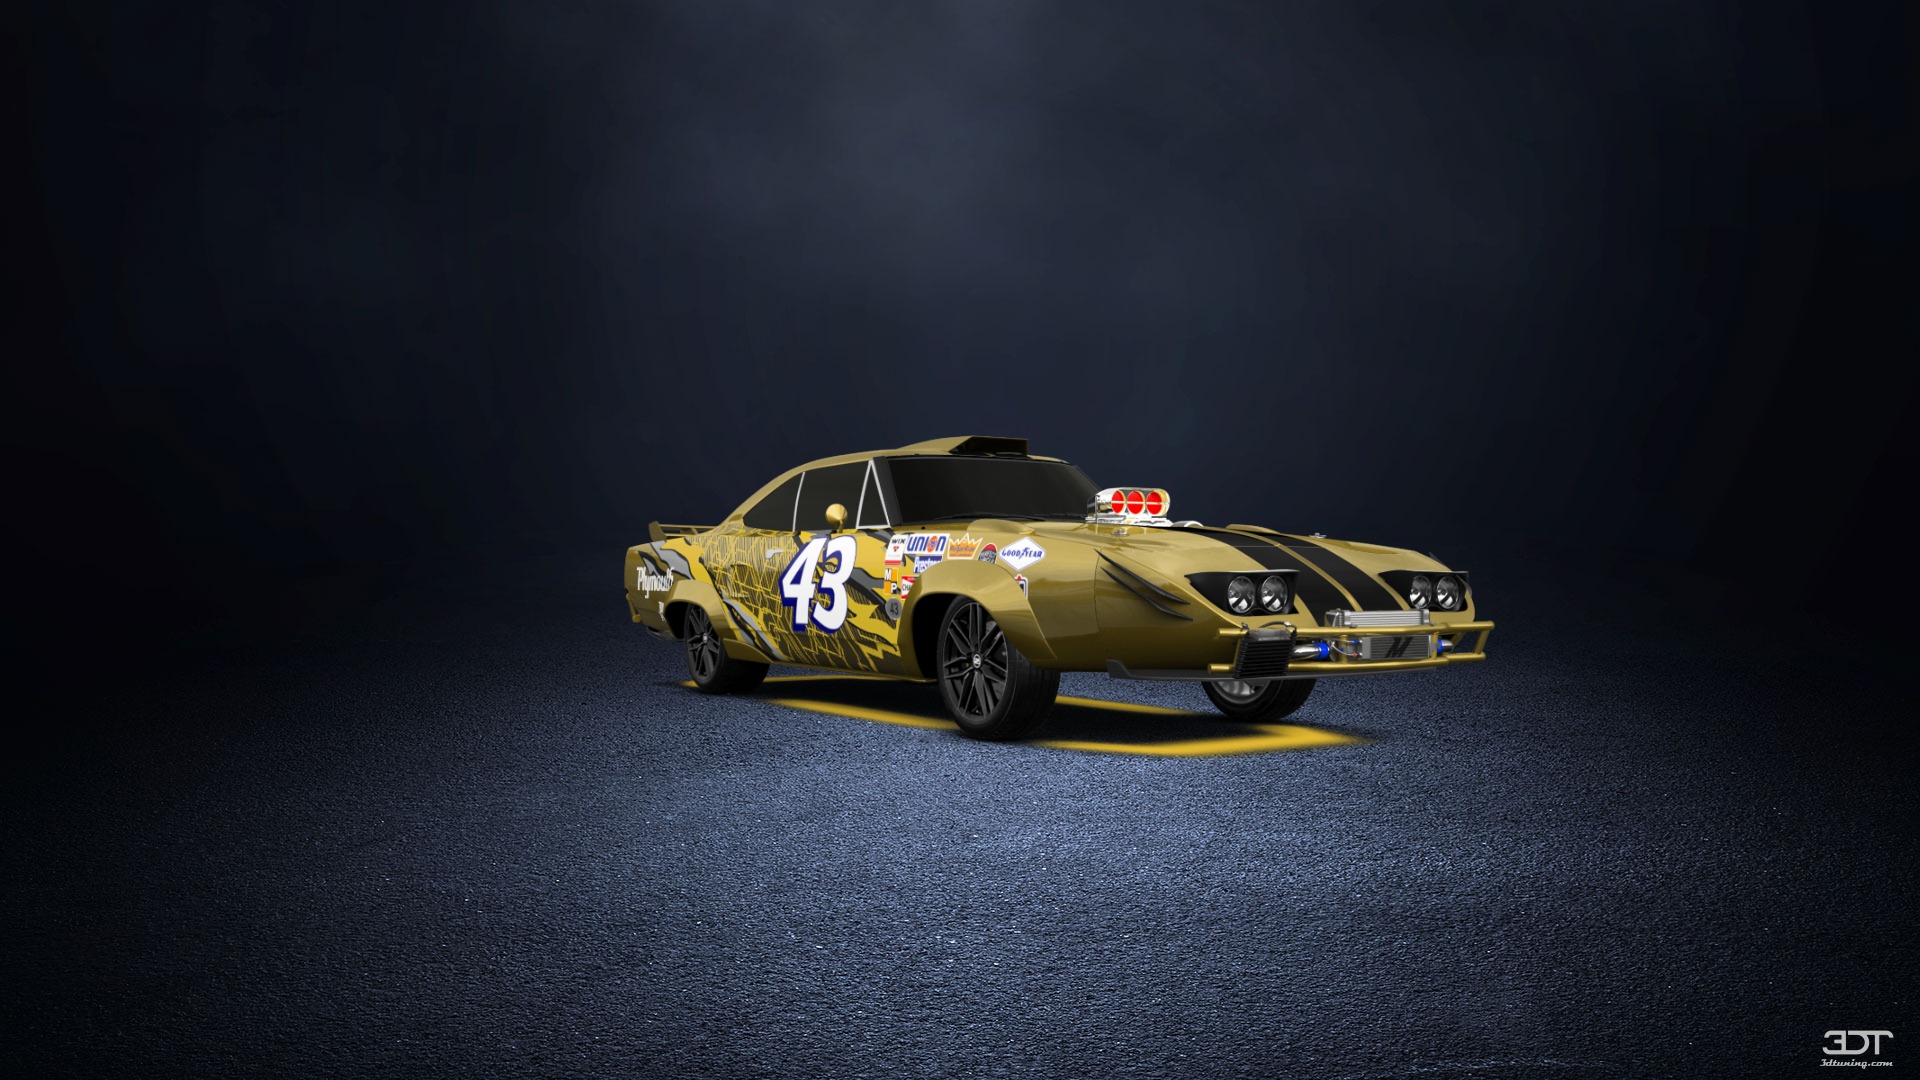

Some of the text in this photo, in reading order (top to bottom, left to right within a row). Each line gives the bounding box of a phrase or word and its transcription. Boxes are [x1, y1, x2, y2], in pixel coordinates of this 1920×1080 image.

[907, 536, 947, 552] UNION
[637, 566, 675, 599] Plymouth
[779, 535, 857, 632] 43
[890, 601, 899, 616] 43
